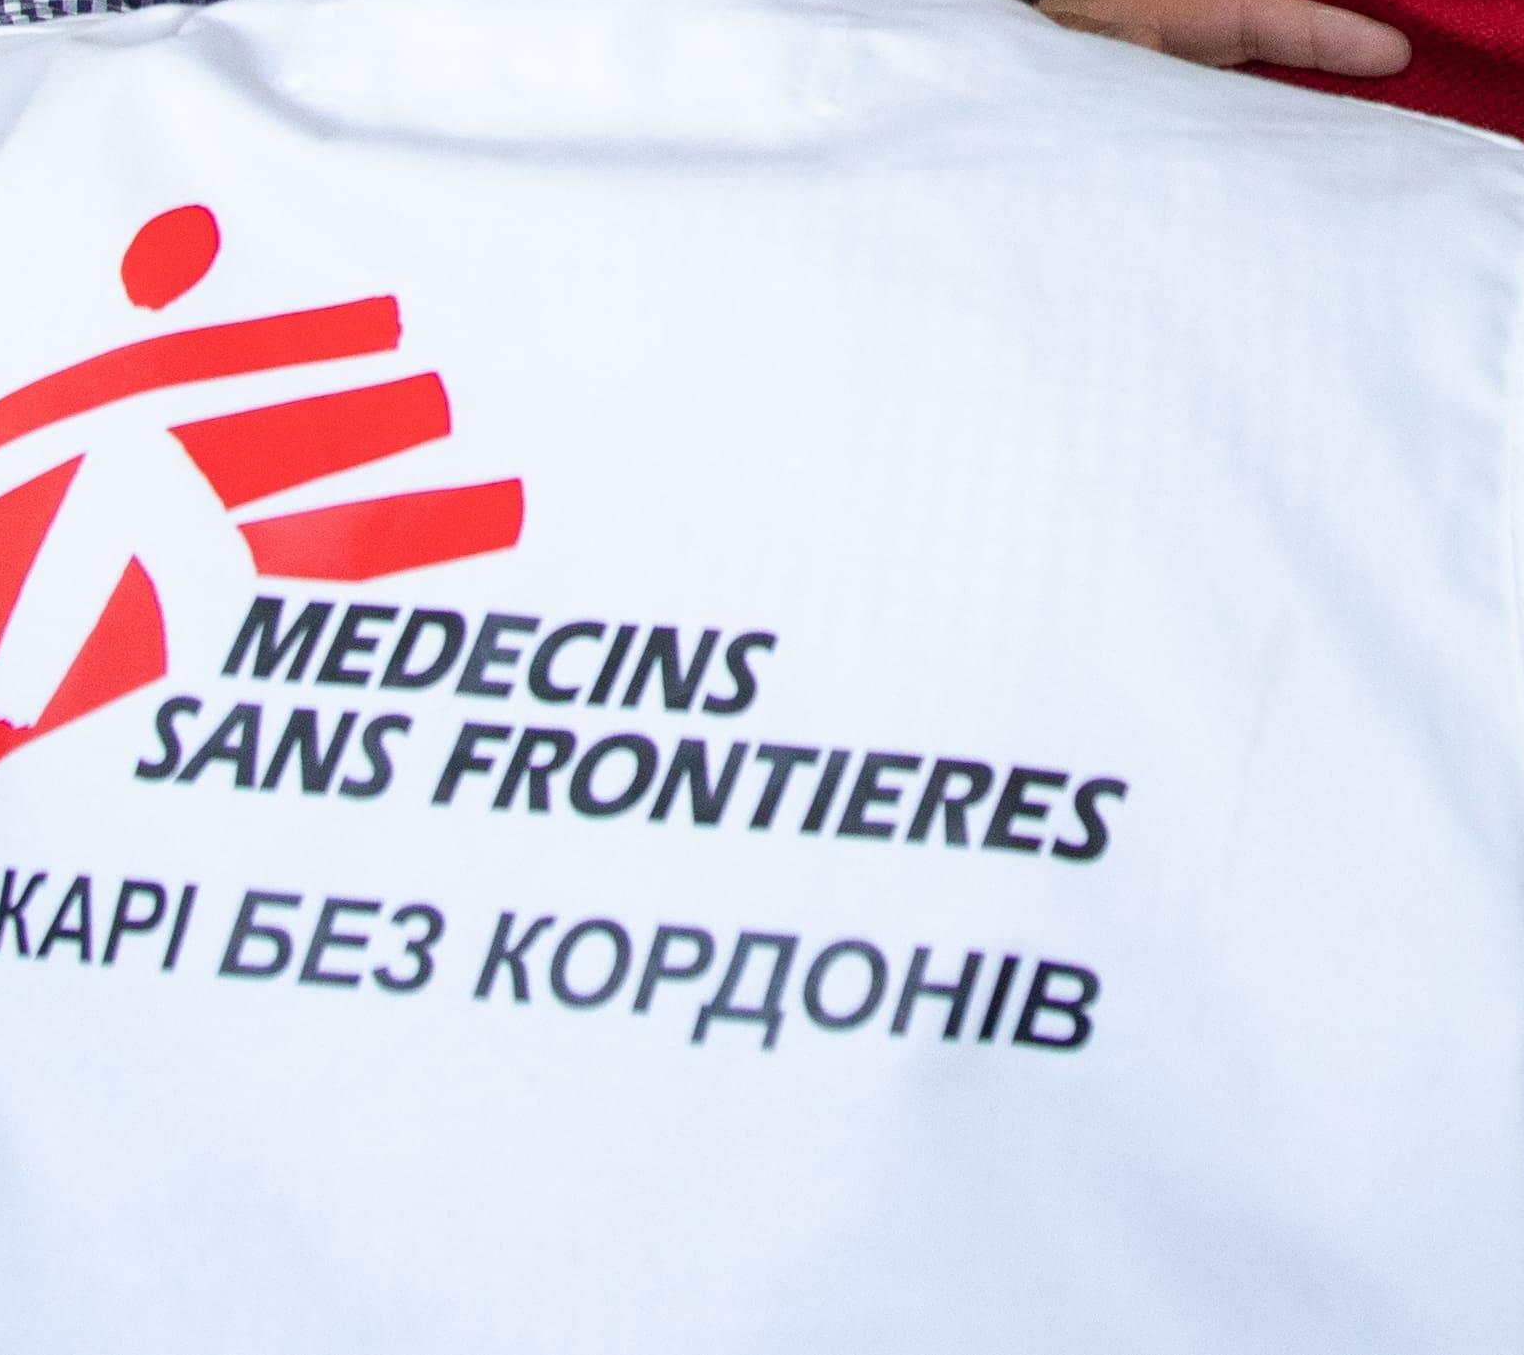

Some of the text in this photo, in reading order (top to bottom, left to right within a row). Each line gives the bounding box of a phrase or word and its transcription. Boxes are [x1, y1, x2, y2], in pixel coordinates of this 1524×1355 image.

[221, 595, 777, 716] MEDECINS
[134, 695, 1129, 863] SANS FRONTIERES
[218, 890, 445, 993] БЕЗ
[474, 912, 1101, 1052] КОРДОНІВ
